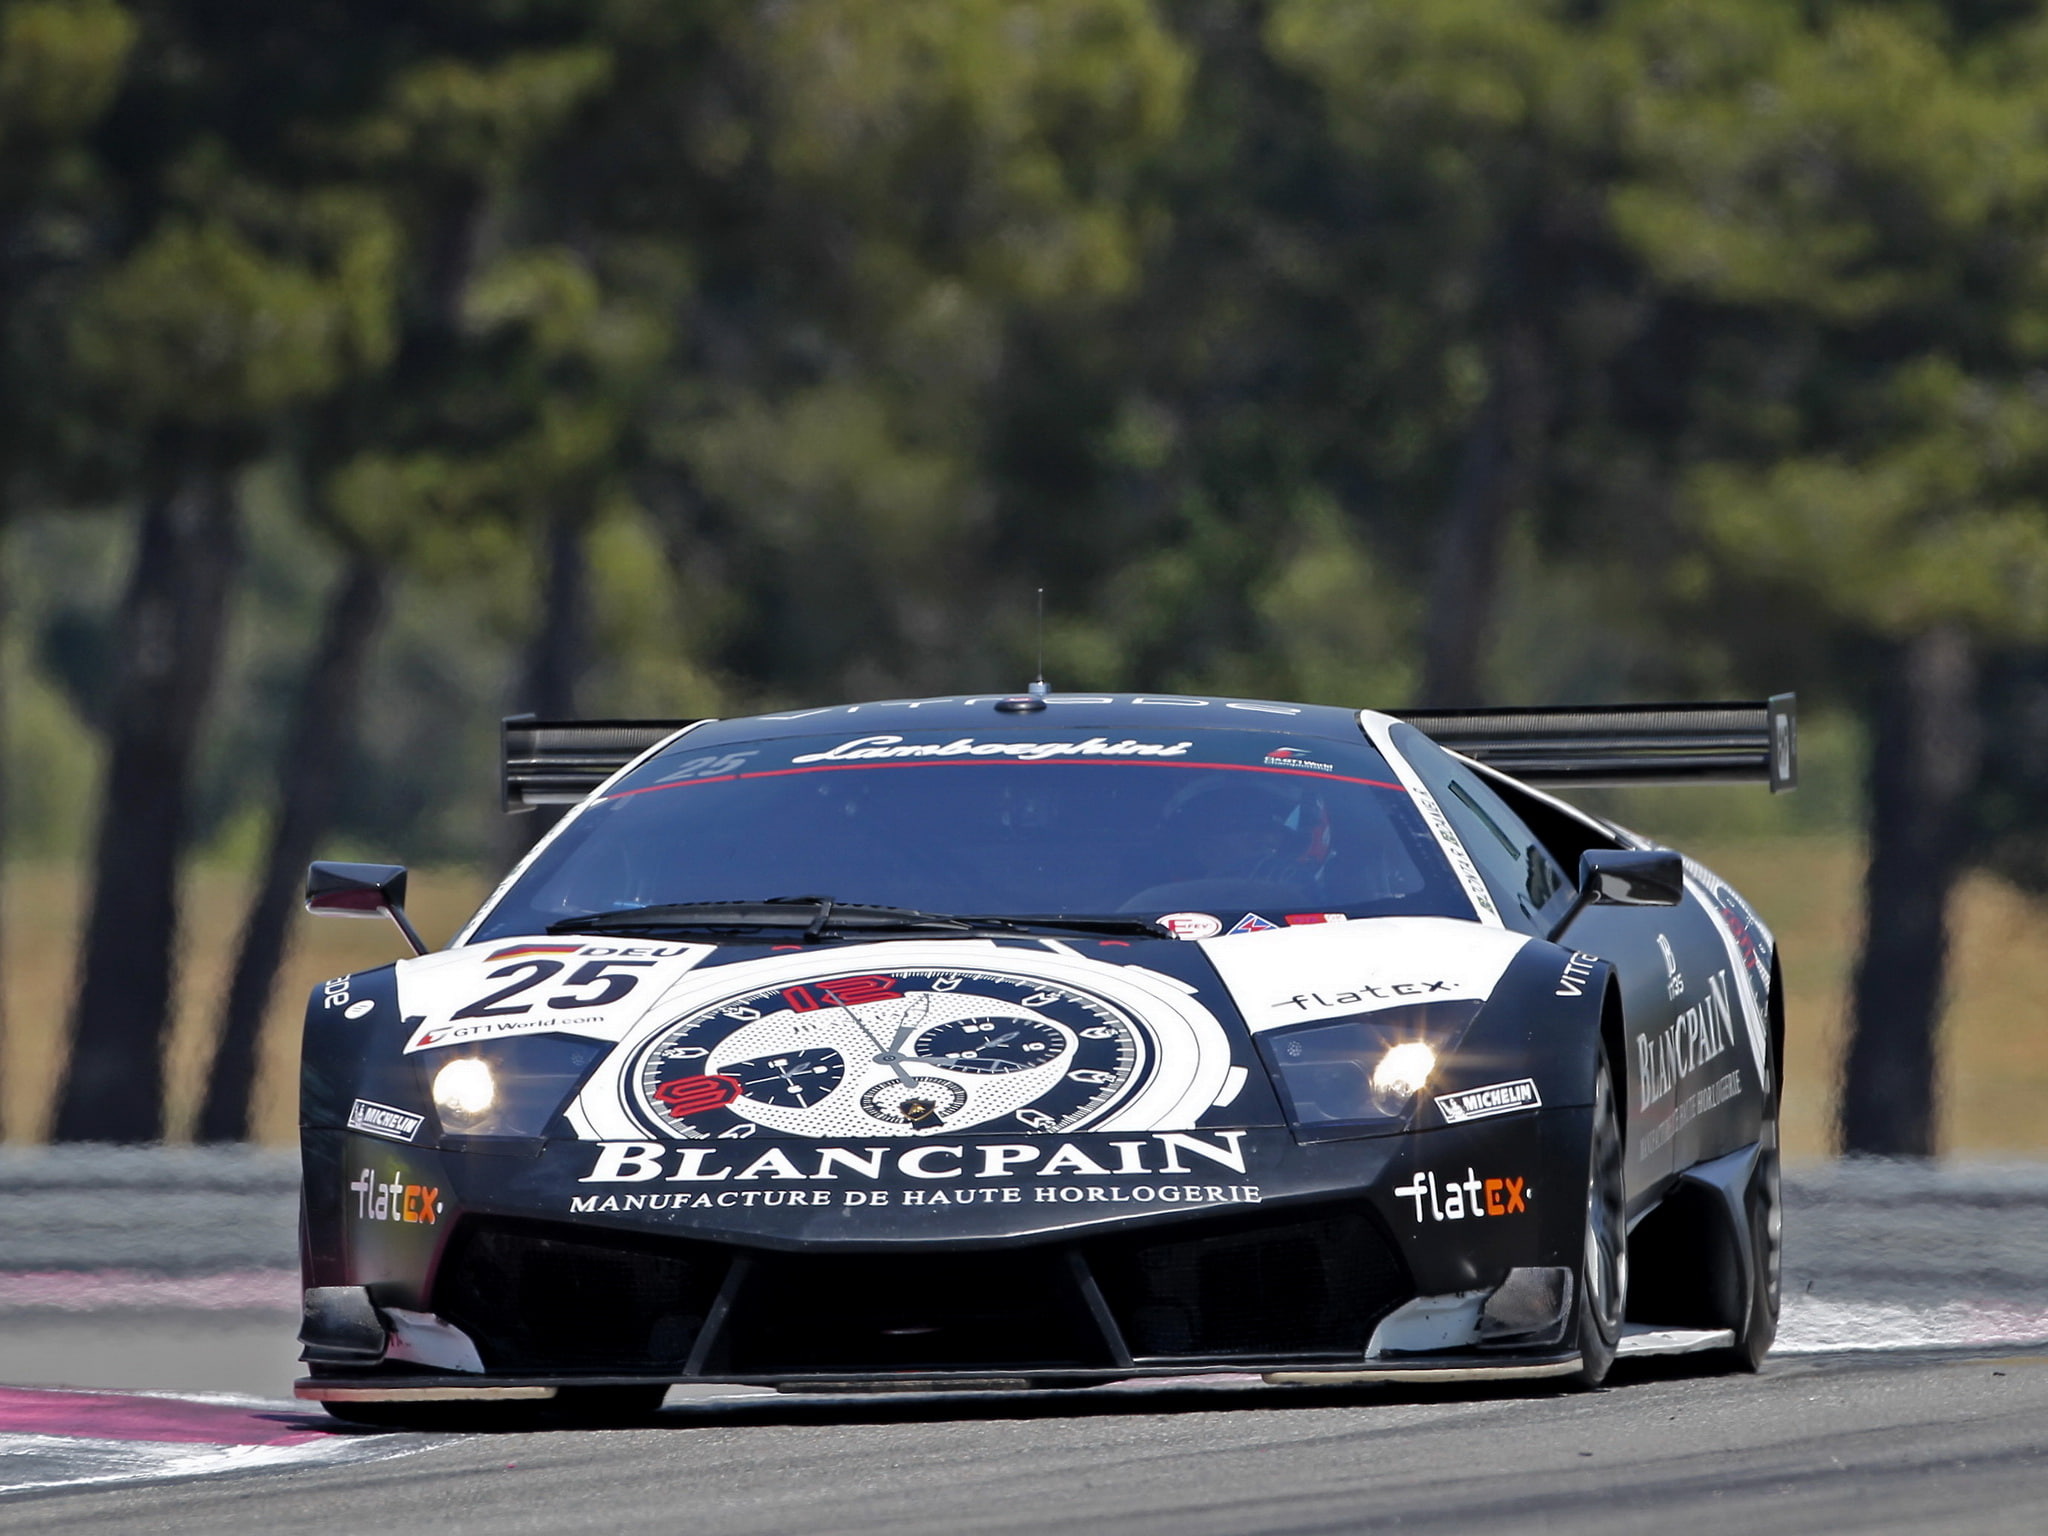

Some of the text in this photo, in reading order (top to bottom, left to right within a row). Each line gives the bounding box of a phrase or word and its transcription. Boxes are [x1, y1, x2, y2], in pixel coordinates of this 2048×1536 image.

[791, 735, 1193, 763] Lamborghini
[655, 750, 760, 783] 25
[579, 947, 690, 957] DEU
[449, 959, 659, 1022] 25
[782, 974, 904, 1014] 12
[1636, 969, 1736, 1114] BLANCPAIN
[1461, 1083, 1533, 1112] MICHELIN
[364, 1106, 419, 1134] MICHELIN
[577, 1130, 1248, 1183] BLANCPAIN
[569, 1185, 1263, 1213] MANUFACTURE DE HAUTE HORLOGERIE
